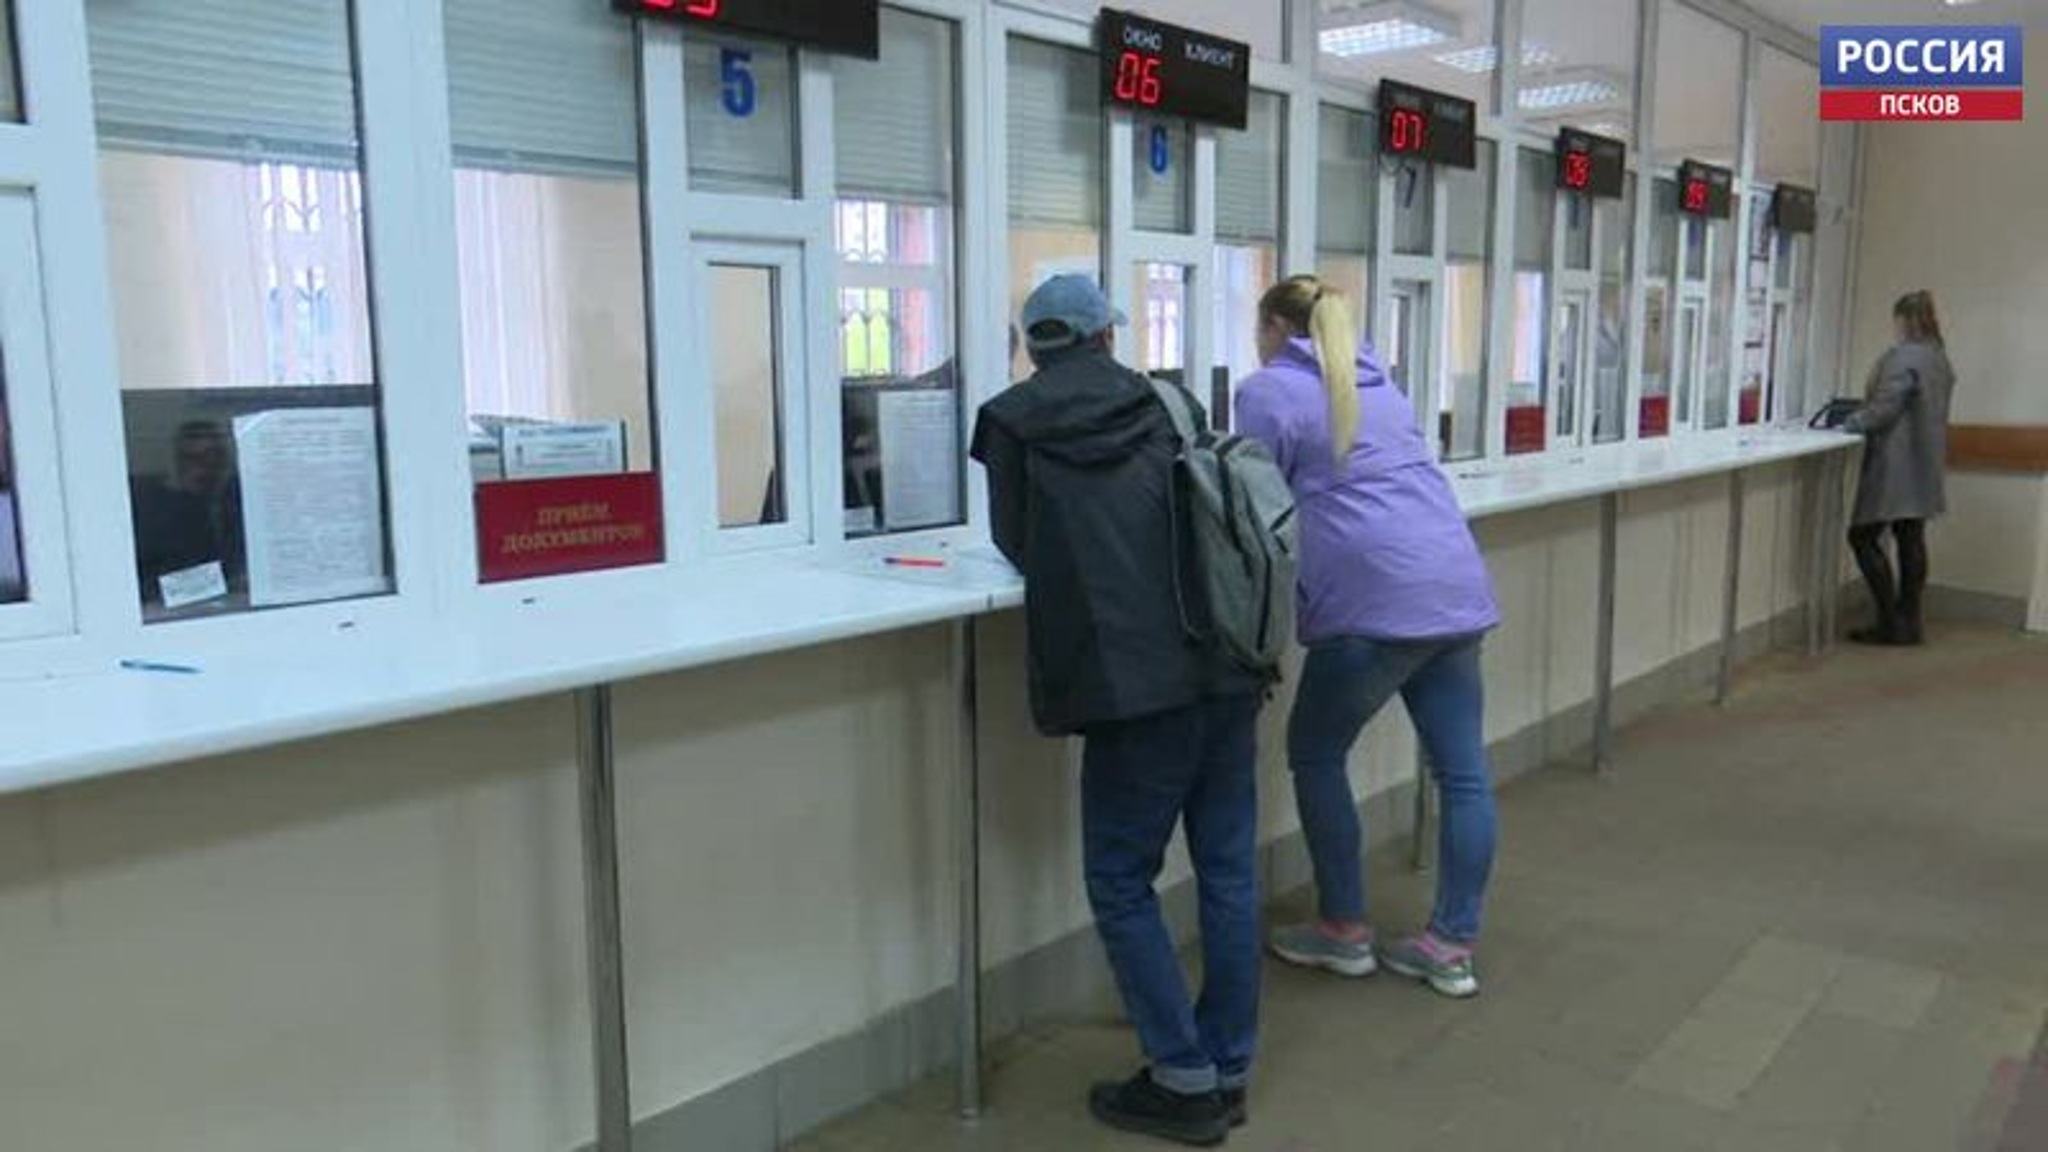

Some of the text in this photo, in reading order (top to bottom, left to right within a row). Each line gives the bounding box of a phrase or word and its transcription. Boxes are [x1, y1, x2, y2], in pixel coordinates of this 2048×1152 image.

[1123, 26, 1234, 70] ОКНО КЛИЕНТ
[720, 48, 756, 117] 5
[1116, 52, 1162, 104] 06
[1150, 125, 1169, 173] 6
[1391, 110, 1424, 151] 07
